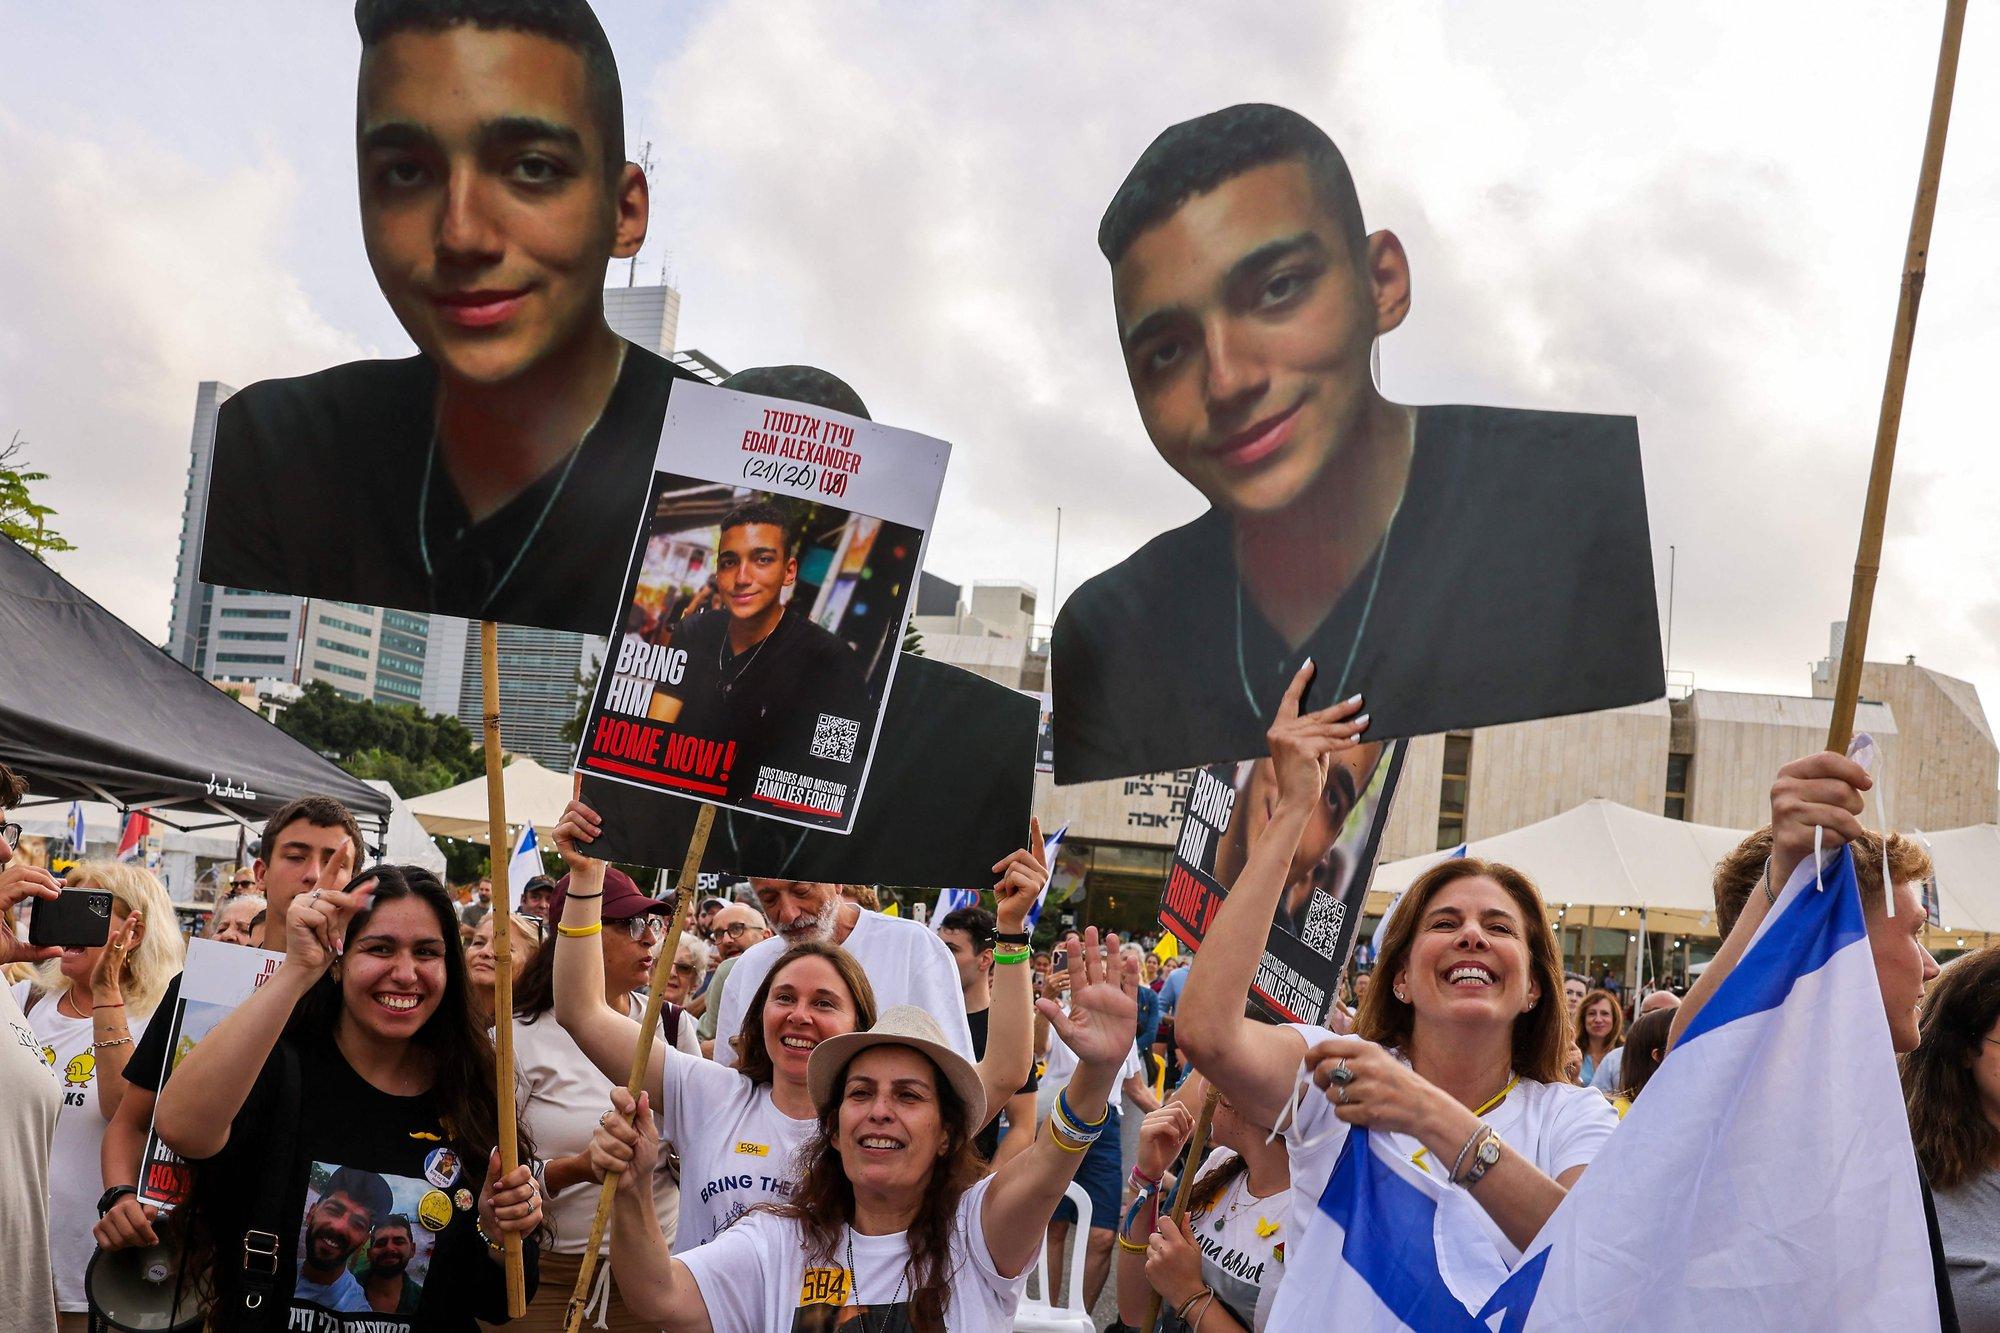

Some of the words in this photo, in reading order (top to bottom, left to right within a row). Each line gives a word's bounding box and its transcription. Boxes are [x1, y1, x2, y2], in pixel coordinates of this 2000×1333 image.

[763, 409, 821, 440] אלכסנדר
[822, 421, 854, 448] עידן
[741, 430, 779, 456] EDAN
[779, 436, 862, 475] ALEXANDER
[614, 637, 688, 686] BRING
[604, 674, 656, 719] HIM
[593, 715, 665, 765] HOME
[663, 732, 736, 782] NOW!
[754, 777, 804, 805] FAMILIES
[803, 788, 845, 814] FORUM
[758, 765, 798, 786] HOSTAGES
[797, 774, 814, 789] AND
[812, 778, 848, 797] MISSING
[1190, 768, 1236, 833] BRING
[1177, 814, 1210, 870] HIM
[1165, 863, 1207, 929] HOME
[1253, 964, 1290, 1007] FAMILIES
[1287, 988, 1320, 1026] FORUM
[1285, 967, 1300, 988] AND
[1297, 975, 1325, 1007] MISSING
[64, 1092, 86, 1107] KS
[740, 1142, 762, 1155] 584
[700, 1174, 753, 1204] BRING
[803, 1270, 846, 1302] 584
